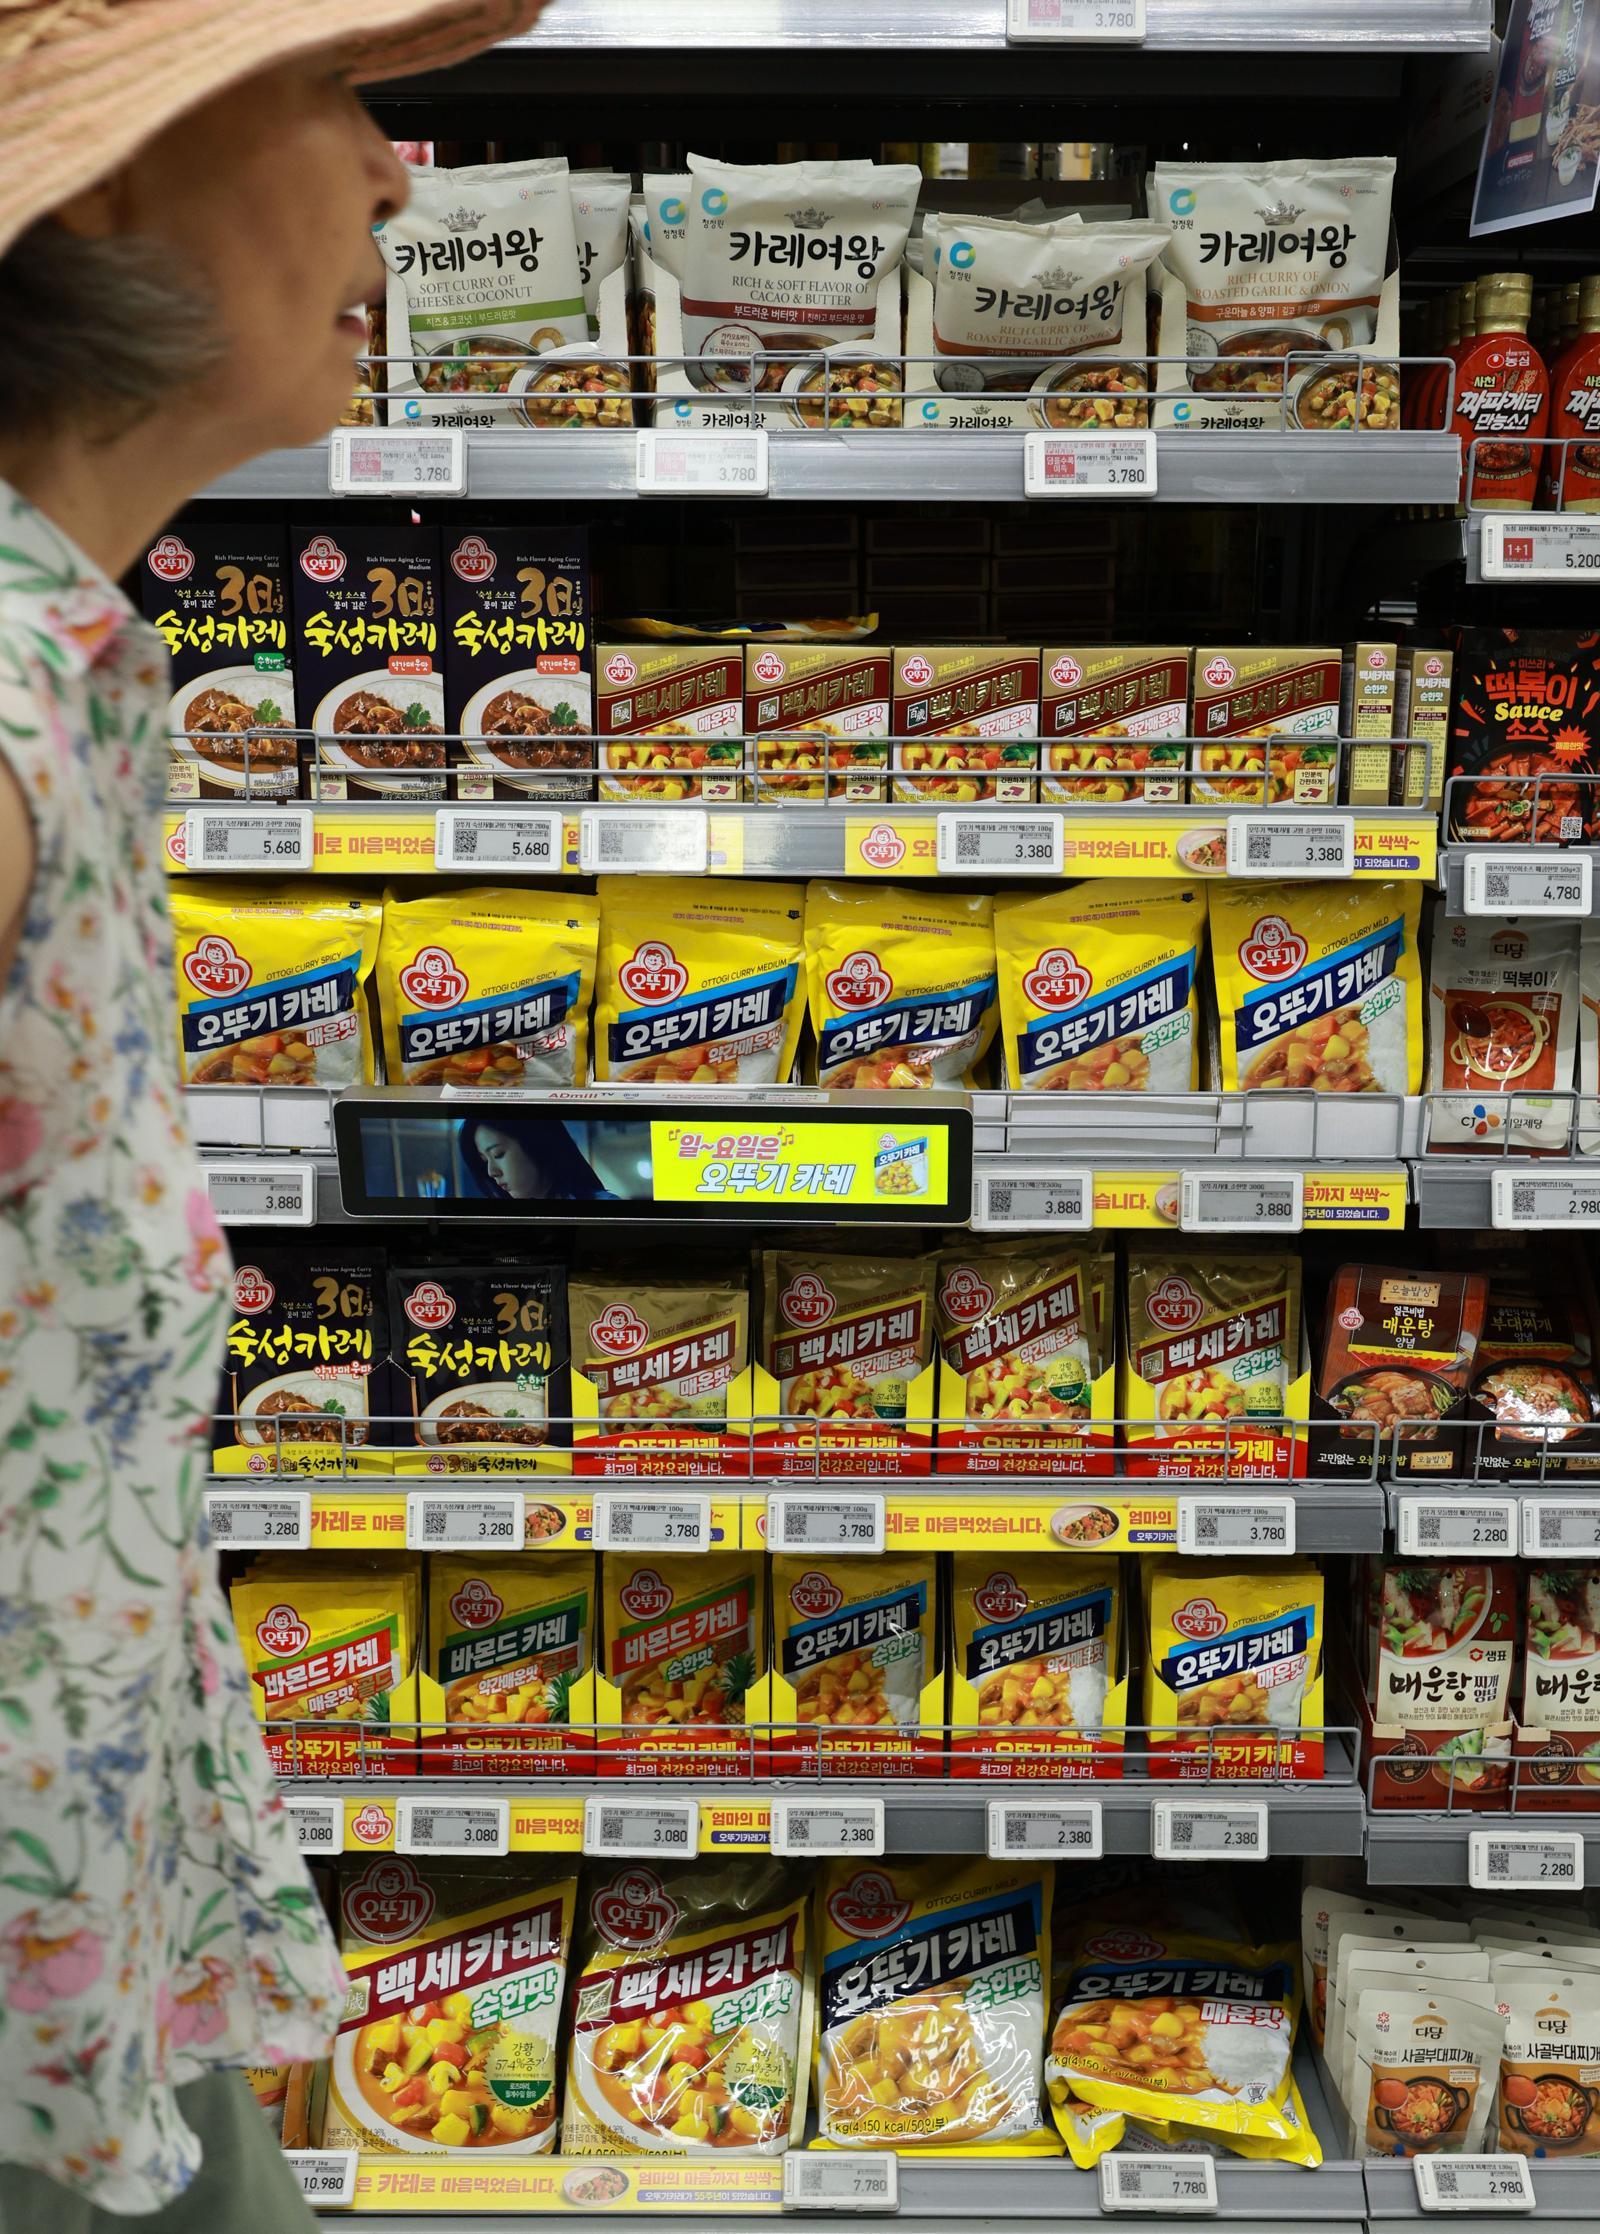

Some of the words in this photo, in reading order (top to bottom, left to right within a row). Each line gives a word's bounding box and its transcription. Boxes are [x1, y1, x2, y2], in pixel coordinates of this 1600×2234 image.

[394, 227, 544, 276] 카레여왕
[730, 231, 885, 280] 카레여왕
[1200, 224, 1356, 269] 카레여왕
[419, 281, 451, 294] SOFT
[453, 277, 495, 292] CURRY
[497, 274, 517, 288] OF
[732, 275, 762, 288] RICH
[765, 277, 774, 288] &
[776, 279, 806, 291] SOFT
[808, 280, 853, 293] FLAVOR
[1228, 273, 1258, 286] RICH
[1260, 272, 1301, 284] CURRY
[1303, 271, 1321, 284] OF
[407, 293, 456, 309] CHEESE
[466, 285, 533, 304] COCONUT
[750, 290, 789, 304] CACAO
[792, 292, 802, 304] &
[804, 292, 852, 306] BUTTER
[975, 280, 1123, 322] 카레여왕
[733, 305, 770, 321] 부드러운
[772, 308, 799, 323] 버터맛
[1504, 354, 1530, 367] 농심
[1457, 390, 1543, 415] 짜파게티
[1108, 469, 1146, 484] 3,780
[1507, 544, 1529, 557] 1+1
[310, 559, 338, 572] 오뚜기
[459, 559, 488, 571] 오뚜기
[1565, 554, 1600, 569] 5,200
[154, 609, 287, 656] 숙성카레
[303, 611, 437, 657] 숙성카레
[453, 611, 585, 656] 숙성카레
[391, 660, 430, 673] 약간매운맛
[1359, 671, 1395, 682] 백세카레
[636, 667, 728, 718] 백세카레
[1079, 668, 1172, 721] 백세카레
[1363, 684, 1389, 695] 순한맛
[1485, 670, 1578, 710] 떡볶이
[697, 706, 738, 732] 매운맛
[1292, 710, 1332, 734] 순한맛
[1494, 702, 1565, 722] Sauce
[1506, 719, 1549, 741] 소스
[264, 840, 301, 854] 5,680
[512, 842, 549, 856] 5,680
[1014, 844, 1053, 859] 3,380
[1379, 833, 1420, 851] 싹싹~
[1306, 847, 1343, 861] 3,380
[1365, 857, 1411, 870] 되었습니다.
[1543, 886, 1581, 901] 4,780
[1322, 937, 1349, 955] OTTOGI
[1349, 926, 1371, 942] CURRY
[1372, 916, 1389, 930] MILD
[1252, 947, 1296, 968] 오뚜기
[1494, 944, 1524, 960] 다담
[632, 973, 676, 992] 오뚜기
[701, 976, 730, 989] OTTOGI
[731, 967, 755, 981] CURRY
[757, 957, 788, 974] MEDIUM
[1503, 970, 1548, 988] 떡볶이
[1252, 974, 1334, 1041] 오뚜기
[1337, 944, 1386, 1000] 카레
[197, 997, 279, 1047] 오뚜기
[282, 979, 339, 1022] 카레
[623, 1011, 706, 1057] 오뚜기
[712, 989, 769, 1033] 카레
[1035, 1006, 1115, 1066] 오뚜기
[1120, 976, 1174, 1029] 카레
[305, 1014, 358, 1048] 매운맛
[409, 1013, 490, 1059] 오뚜기
[495, 995, 552, 1036] 카레
[826, 1012, 910, 1064] 오뚜기
[913, 1000, 973, 1036] 카레
[1140, 1012, 1191, 1056] 순한맛
[708, 1024, 783, 1065] 약간매운맛
[1461, 1116, 1475, 1129] CJ
[679, 1133, 780, 1161] 일~요일은
[696, 1163, 790, 1194] 오뚜기
[790, 1164, 856, 1195] 카레
[265, 1195, 303, 1211] 3,880
[1044, 1199, 1082, 1215] 3,880
[1255, 1202, 1293, 1217] 3,880
[1390, 1283, 1433, 1299] 오늘밥상
[798, 1309, 915, 1365] 백세카레
[1168, 1307, 1280, 1368] 백세카레
[1382, 1315, 1435, 1339] 매운탕
[226, 1319, 373, 1367] 숙성카레
[1395, 1336, 1416, 1349] 양념
[406, 1332, 552, 1379] 숙성카레
[613, 1330, 729, 1387] 백세카레
[679, 1364, 734, 1398] 매운맛
[604, 1462, 637, 1476] 최고의
[641, 1461, 725, 1477] 건강요리입니다.
[264, 1522, 300, 1536] 3,280
[478, 1522, 514, 1536] 3,280
[664, 1523, 700, 1538] 3,780
[925, 1517, 1046, 1535] 마음먹었습니다.
[1472, 1528, 1508, 1542] 2,280
[1232, 1616, 1258, 1629] OTTOGI
[1258, 1609, 1281, 1622] CURRY
[1281, 1601, 1301, 1615] SPICY
[451, 1630, 519, 1674] 바몬드
[521, 1614, 567, 1654] 카레
[795, 1619, 859, 1667] 오뚜기
[863, 1602, 907, 1639] 카레
[667, 1646, 715, 1683] 순한맛
[1175, 1641, 1245, 1687] 오뚜기
[1247, 1626, 1295, 1666] 카레
[1485, 1649, 1507, 1662] 샘표
[264, 1656, 332, 1698] 바몬드
[333, 1637, 380, 1676] 카레
[1256, 1655, 1310, 1690] 매운맛
[1389, 1665, 1472, 1703] 매운탕
[1473, 1674, 1500, 1688] 찌개
[1474, 1688, 1498, 1703] 양념
[980, 1763, 1011, 1776] 최고의
[1014, 1764, 1096, 1778] 건강요리입니다.
[711, 1811, 756, 1828] 엄마의
[464, 1829, 499, 1843] 3,080
[718, 1831, 769, 1844] 오뚜기카레가
[840, 1828, 874, 1843] 2,380
[1540, 1862, 1575, 1877] 2,280
[361, 1899, 417, 1921] 오뚜기
[376, 1911, 552, 2005] 백세카레
[618, 1925, 788, 2010] 백세카레
[834, 1934, 942, 2018] 오뚜기
[947, 1912, 1017, 1971] 카레
[1072, 1970, 1184, 2000] 오뚜기
[1188, 1969, 1264, 1998] 카레
[471, 1967, 559, 2030] 순한맛
[1200, 2000, 1285, 2031] 매운맛
[1415, 2025, 1444, 2041] 다담
[1401, 2048, 1474, 2065] 사골부대찌개
[303, 2176, 344, 2192] 10,980
[378, 2172, 436, 2194] 카레로
[442, 2176, 558, 2194] 마음먹었습니다.
[853, 2178, 888, 2193] 7,780
[1489, 2181, 1524, 2196] 2,980
